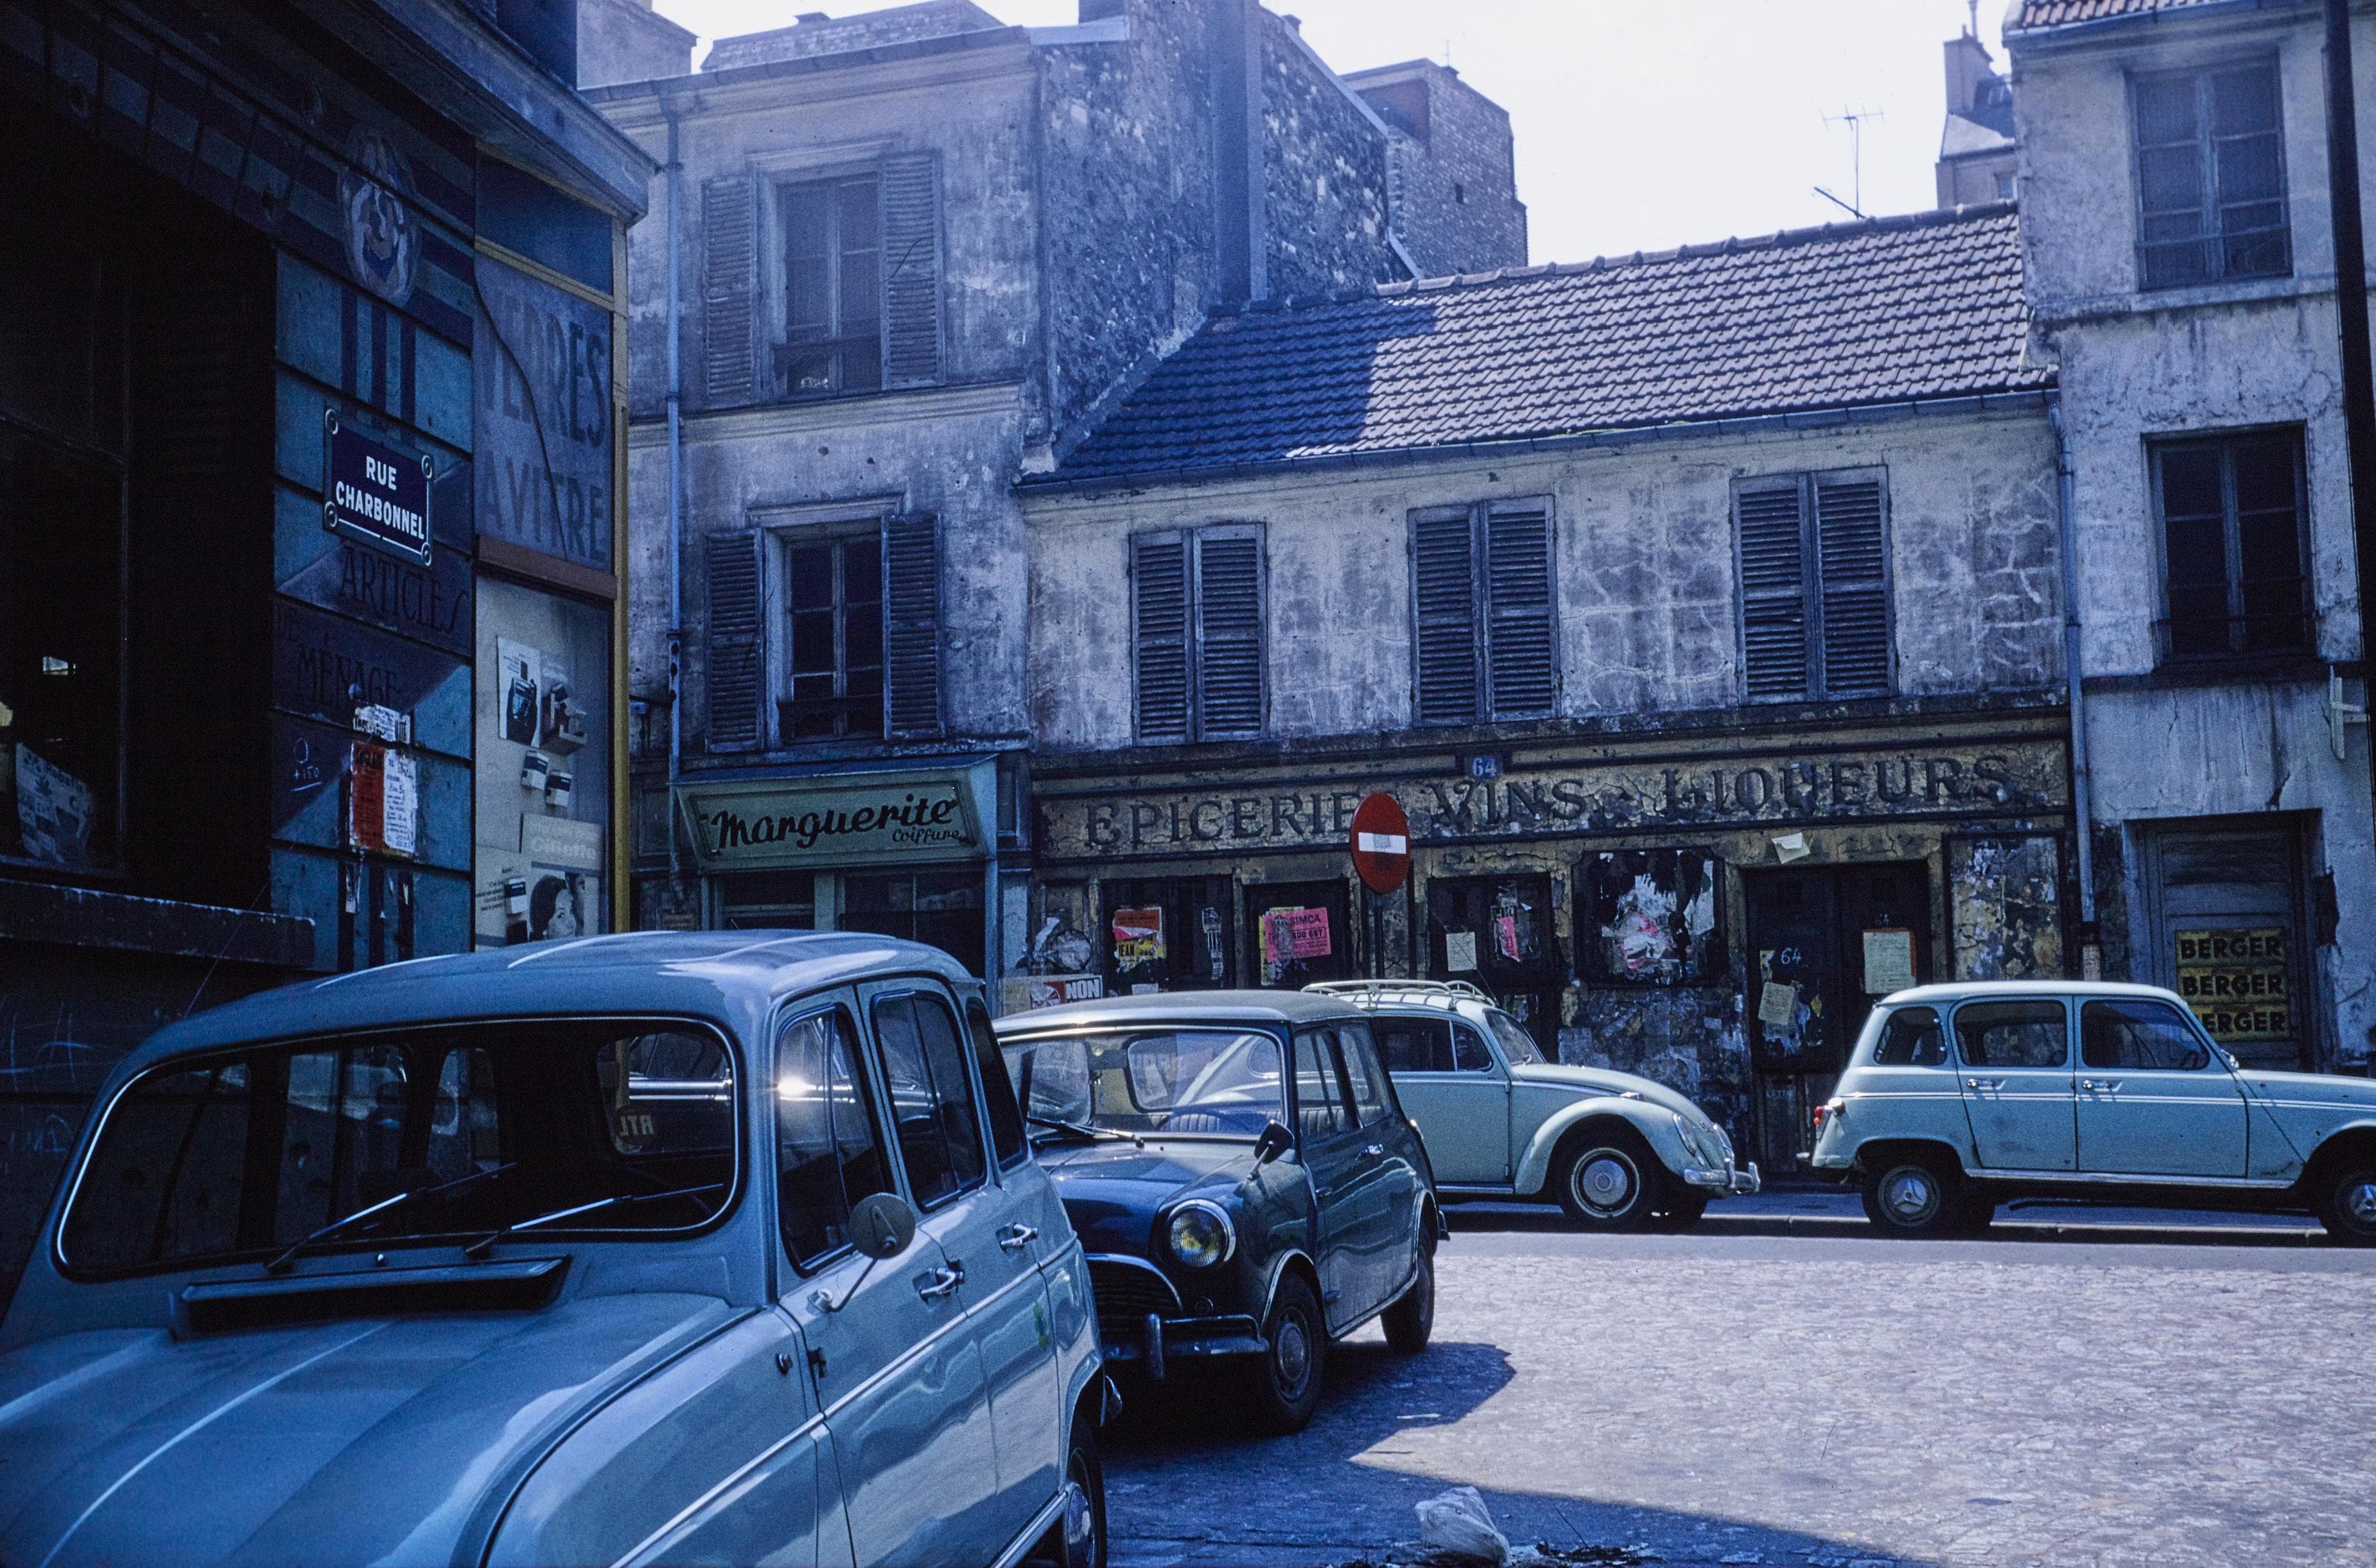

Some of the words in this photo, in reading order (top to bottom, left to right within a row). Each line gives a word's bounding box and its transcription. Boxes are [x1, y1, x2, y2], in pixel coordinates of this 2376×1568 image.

[365, 456, 397, 491] RUE
[335, 480, 424, 540] CHARBONNEL
[338, 546, 469, 634] ARTICLES
[1471, 758, 1498, 778] 64
[1085, 790, 1361, 849] EPICERIE
[1423, 778, 1587, 836] VINS
[1660, 754, 2010, 819] LIQUEURS
[710, 793, 959, 849] Marguerite
[891, 827, 959, 846] Coiffure
[1289, 914, 1321, 926] SIMCA
[1309, 929, 1322, 937] EST
[1781, 947, 1801, 964] 64
[2181, 936, 2282, 959] BERGER
[1065, 979, 1100, 1000] NON
[2182, 973, 2284, 996] BERGER
[2197, 1010, 2287, 1033] ERGER
